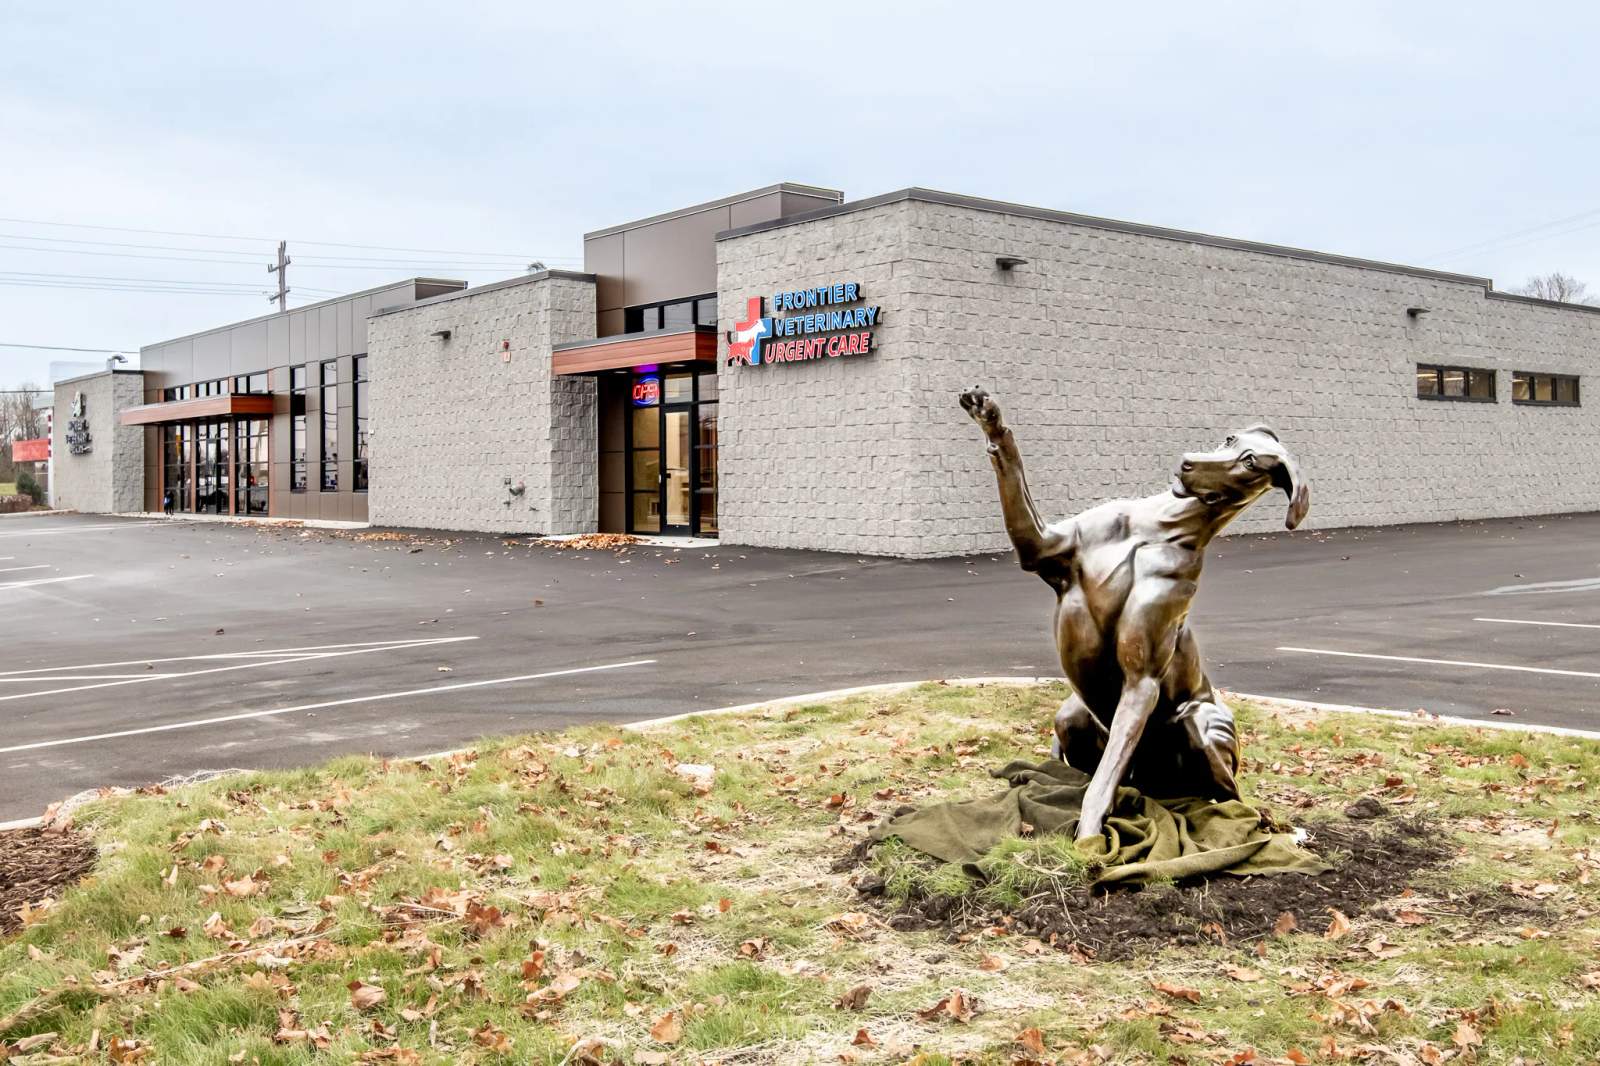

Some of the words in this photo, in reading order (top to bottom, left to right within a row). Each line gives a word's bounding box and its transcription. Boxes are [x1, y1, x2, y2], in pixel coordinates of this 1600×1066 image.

[774, 282, 858, 312] FRONTIER
[774, 305, 878, 337] VETERINARY
[764, 336, 827, 364] URGENT
[827, 332, 871, 357] CARE
